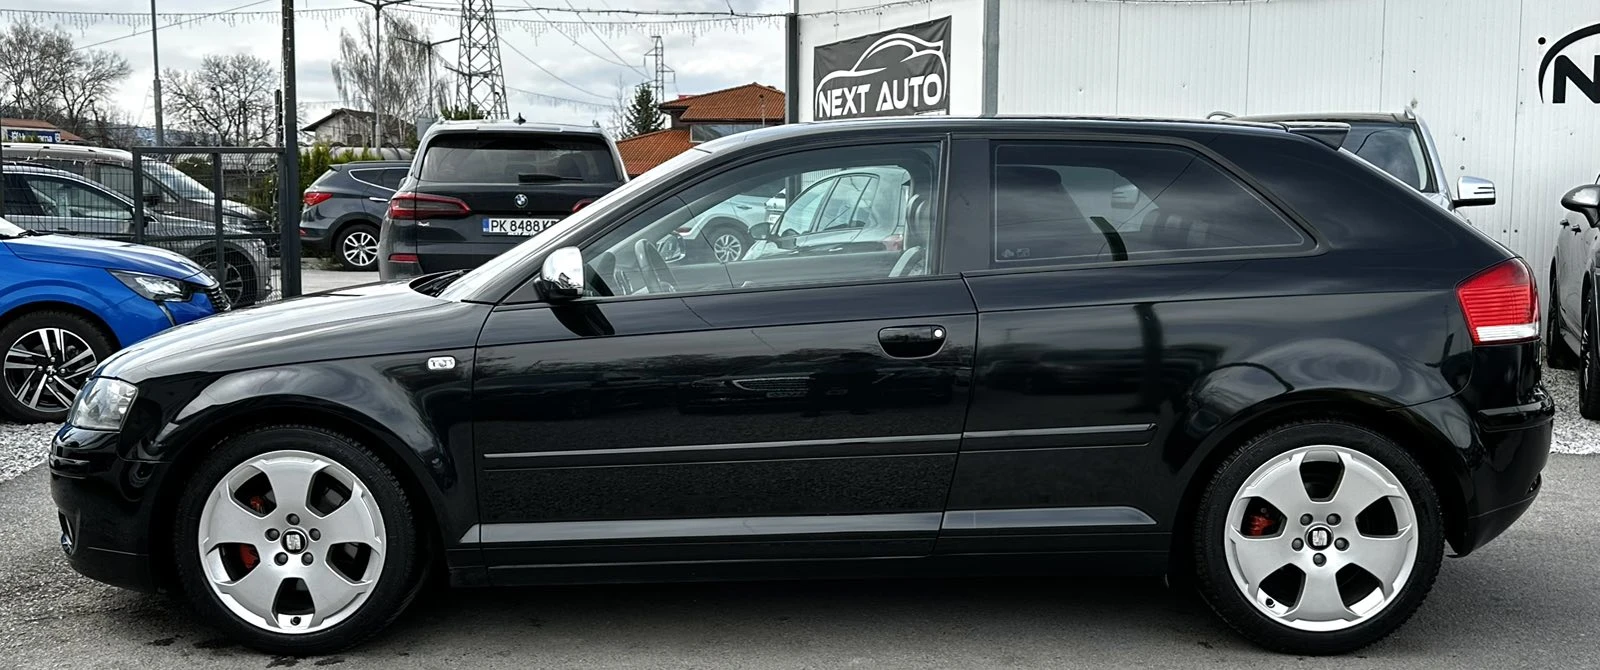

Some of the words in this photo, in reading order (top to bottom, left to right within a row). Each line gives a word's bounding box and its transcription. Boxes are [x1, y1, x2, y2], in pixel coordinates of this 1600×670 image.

[819, 83, 871, 118] NEXT
[875, 73, 942, 112] AUTO
[491, 220, 507, 232] PK
[509, 220, 541, 232] 8488
